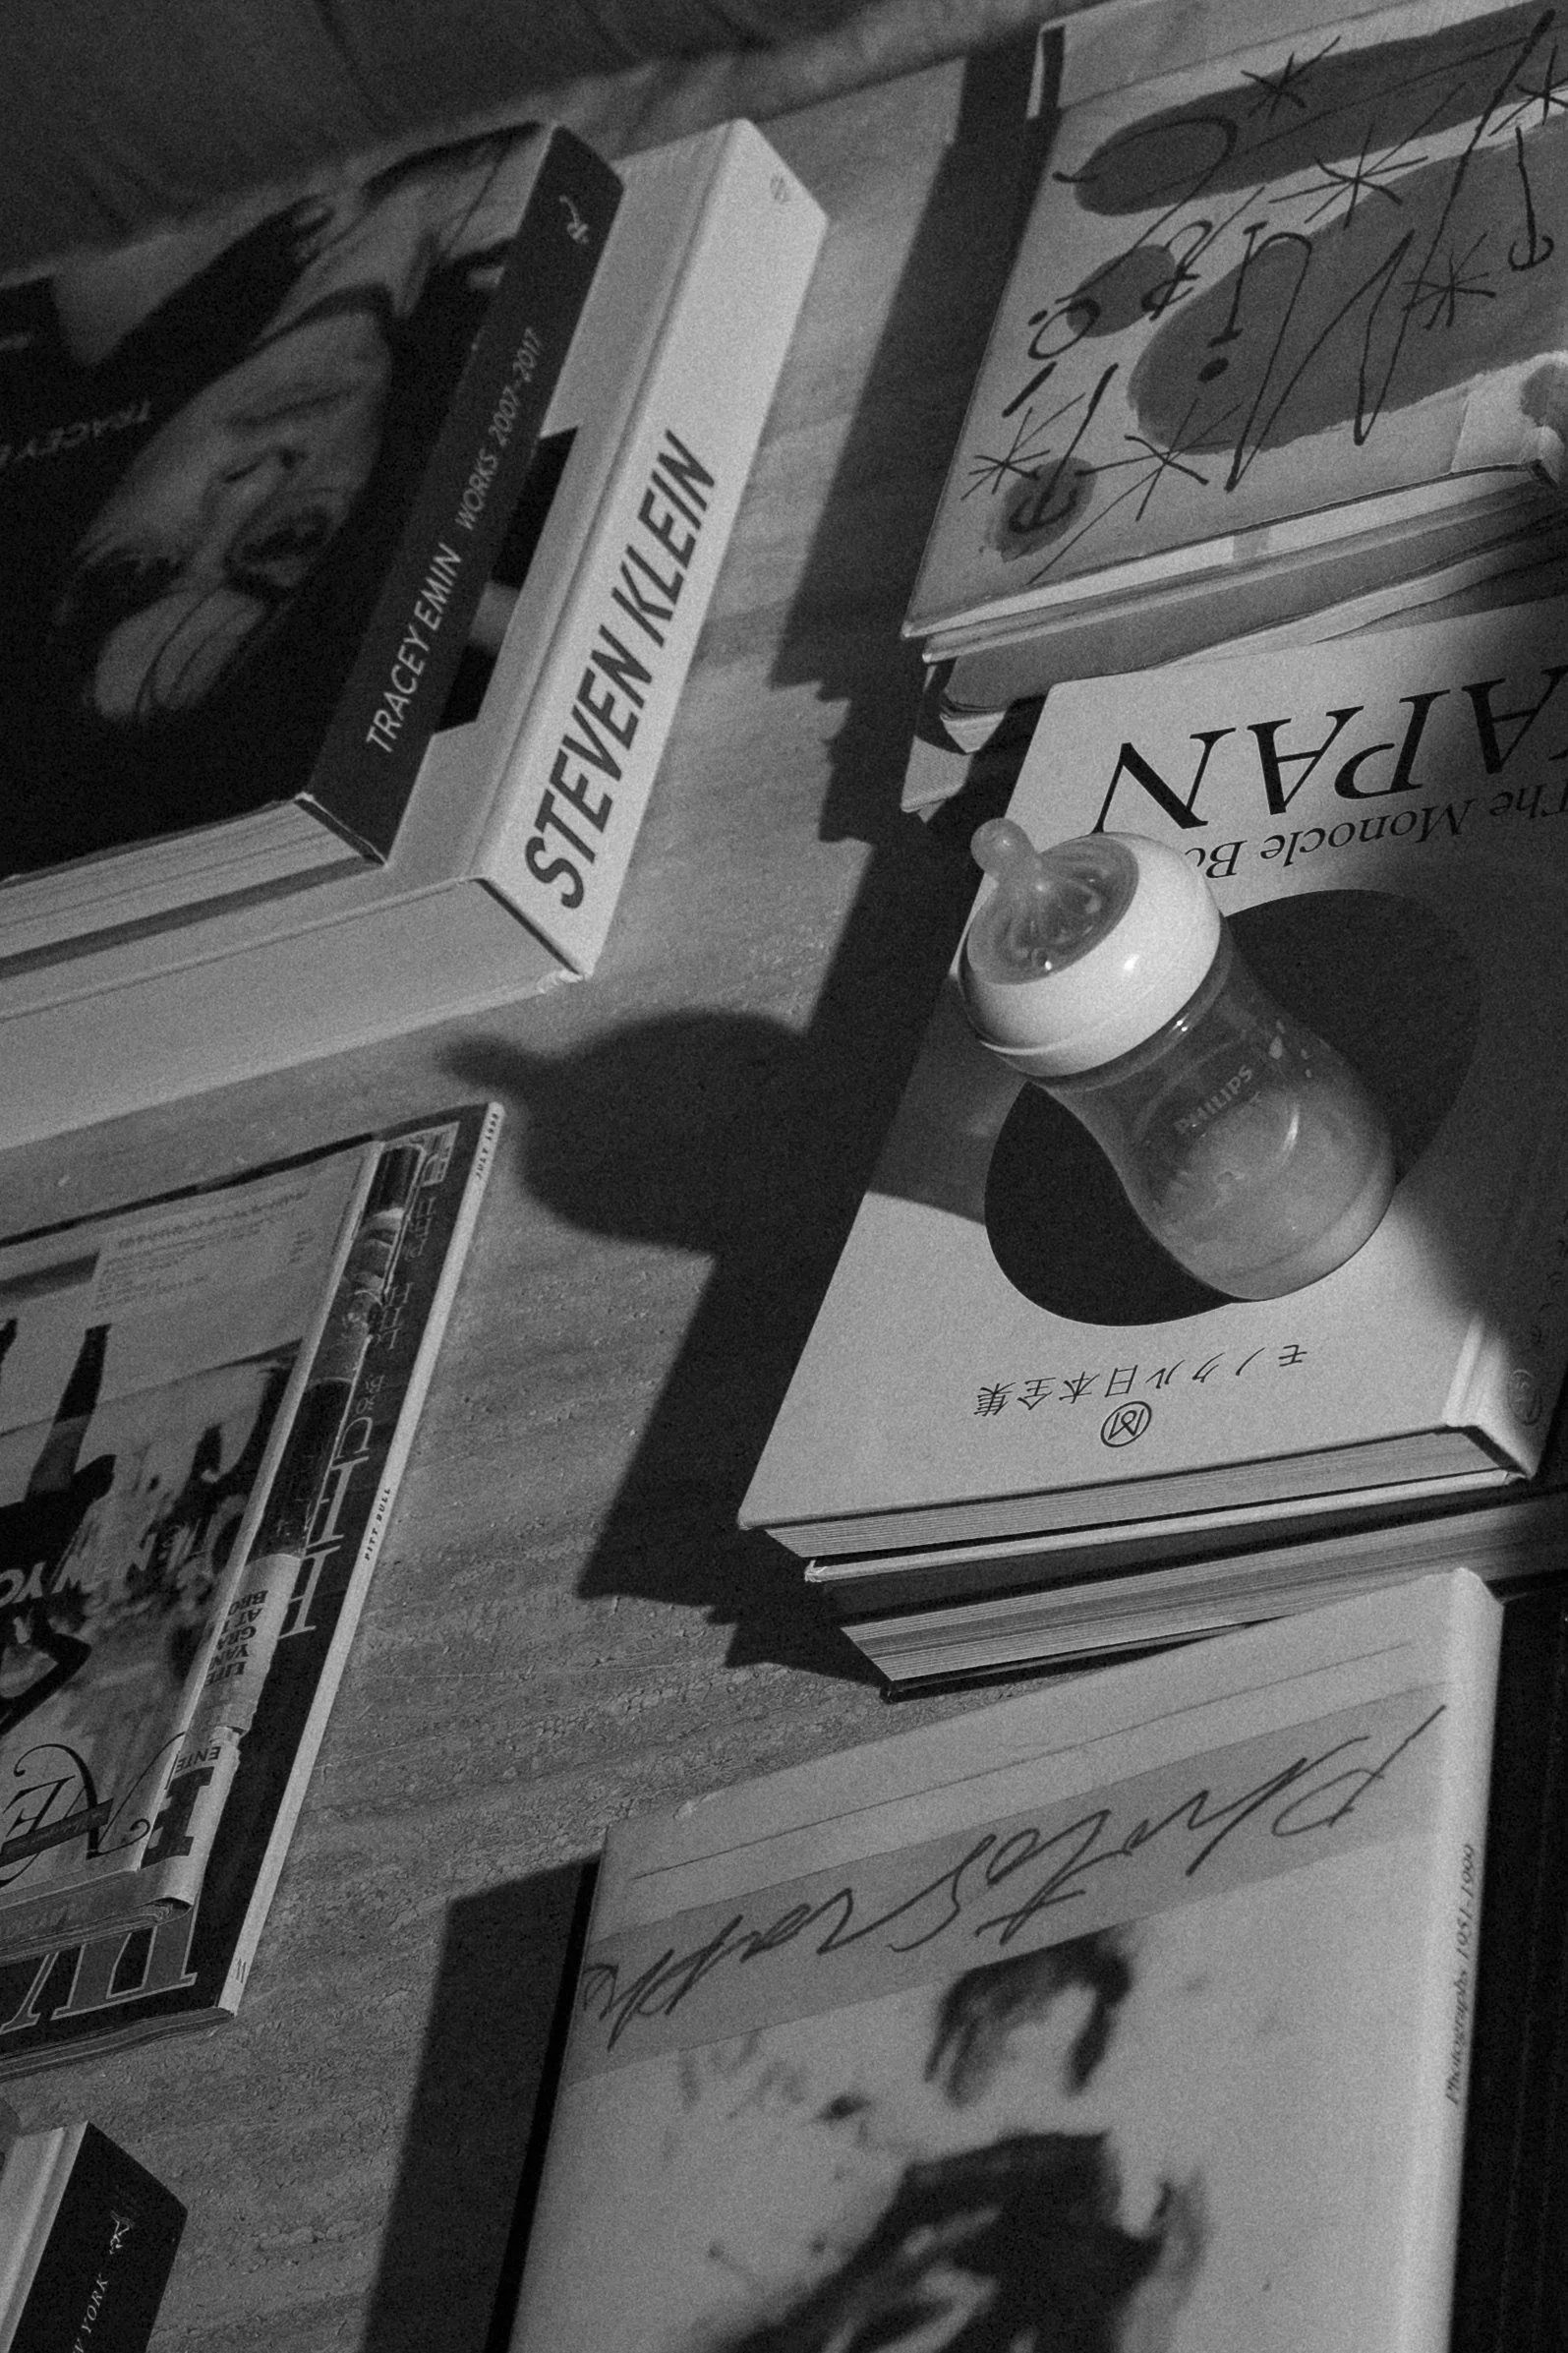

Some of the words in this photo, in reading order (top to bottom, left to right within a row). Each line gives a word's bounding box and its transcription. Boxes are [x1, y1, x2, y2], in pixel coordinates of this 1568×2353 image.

[366, 623, 430, 753] TRACEY
[414, 542, 462, 631] EMIN
[455, 448, 498, 530] WORKS
[489, 327, 542, 447] 2007-2017
[525, 624, 653, 910] STEVEN
[611, 429, 715, 649] KLEIN
[1090, 664, 1568, 834] APAN
[1259, 797, 1476, 867] Monocle
[1173, 1064, 1252, 1135] PHILIPS
[973, 1343, 1307, 1417] モノクル日本全集
[364, 1520, 381, 1561] PITT
[377, 1487, 391, 1522] BULL
[1445, 1970, 1469, 2106] Photographs
[81, 2272, 109, 2333] YORK
